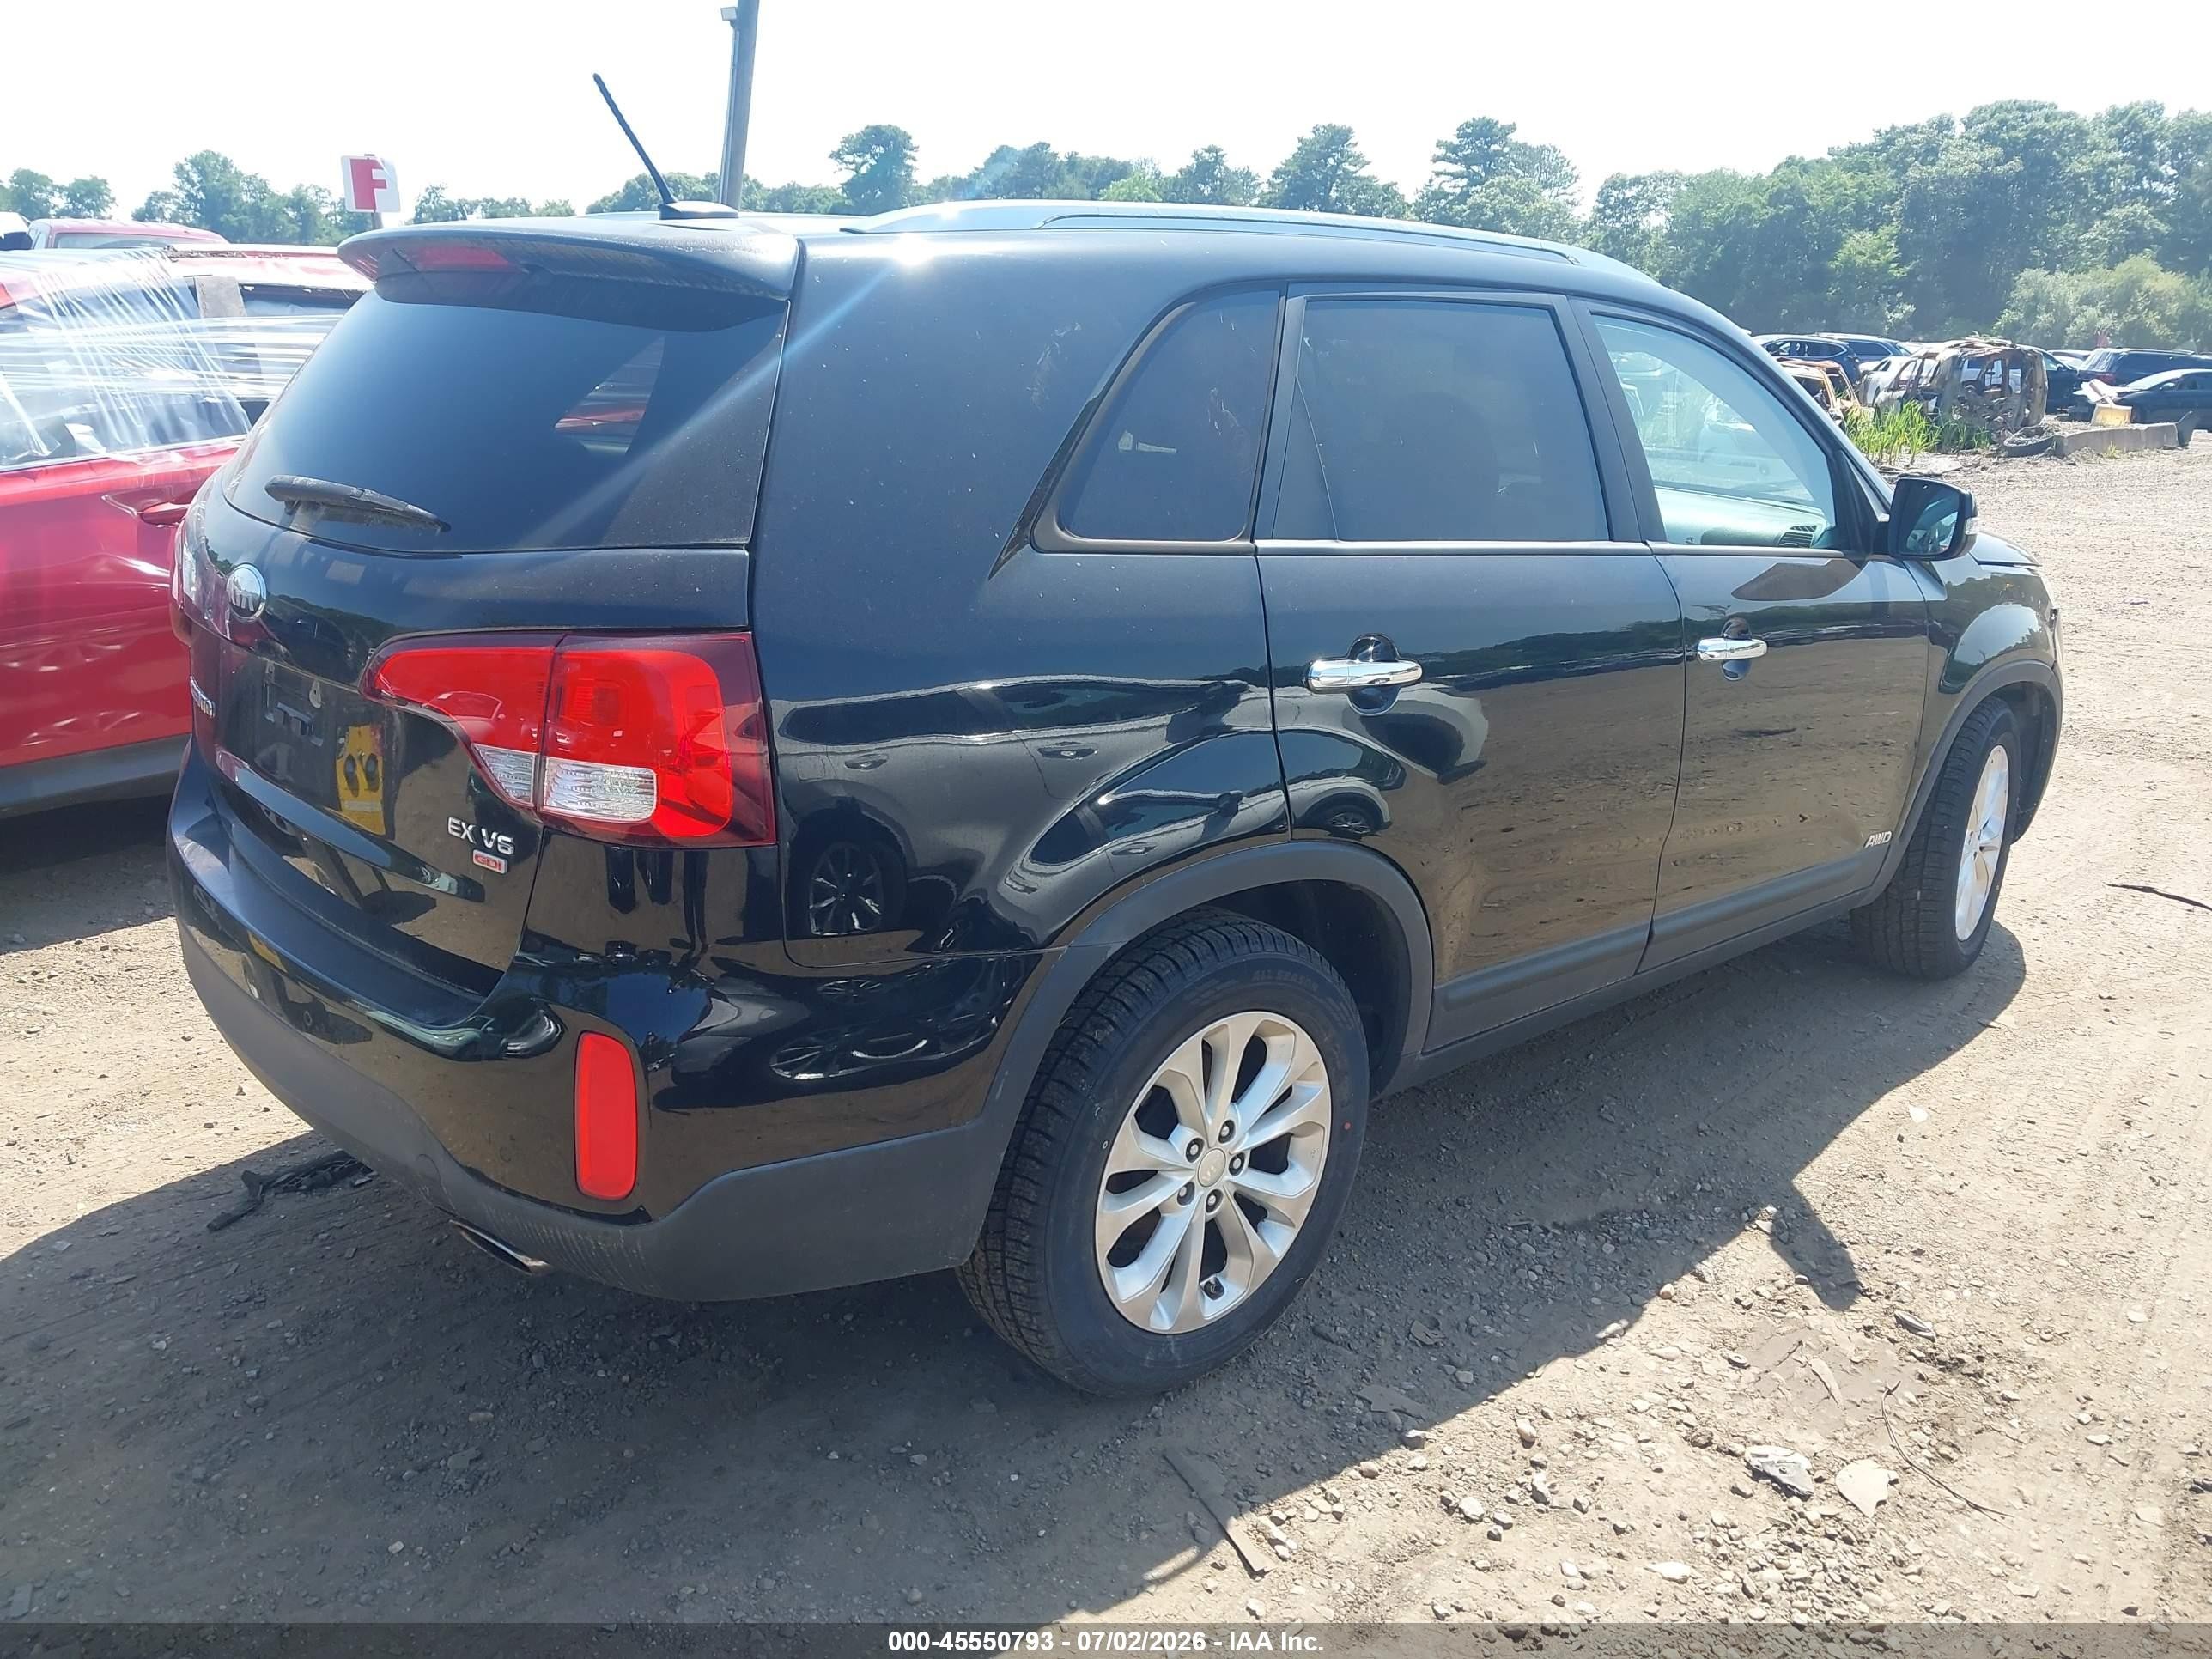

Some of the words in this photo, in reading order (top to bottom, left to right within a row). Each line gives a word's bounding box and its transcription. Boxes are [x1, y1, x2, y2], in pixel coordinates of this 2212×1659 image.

[349, 158, 387, 210] F
[447, 817, 477, 845] EX
[481, 828, 514, 855] V6
[1863, 830, 1893, 848] AWD
